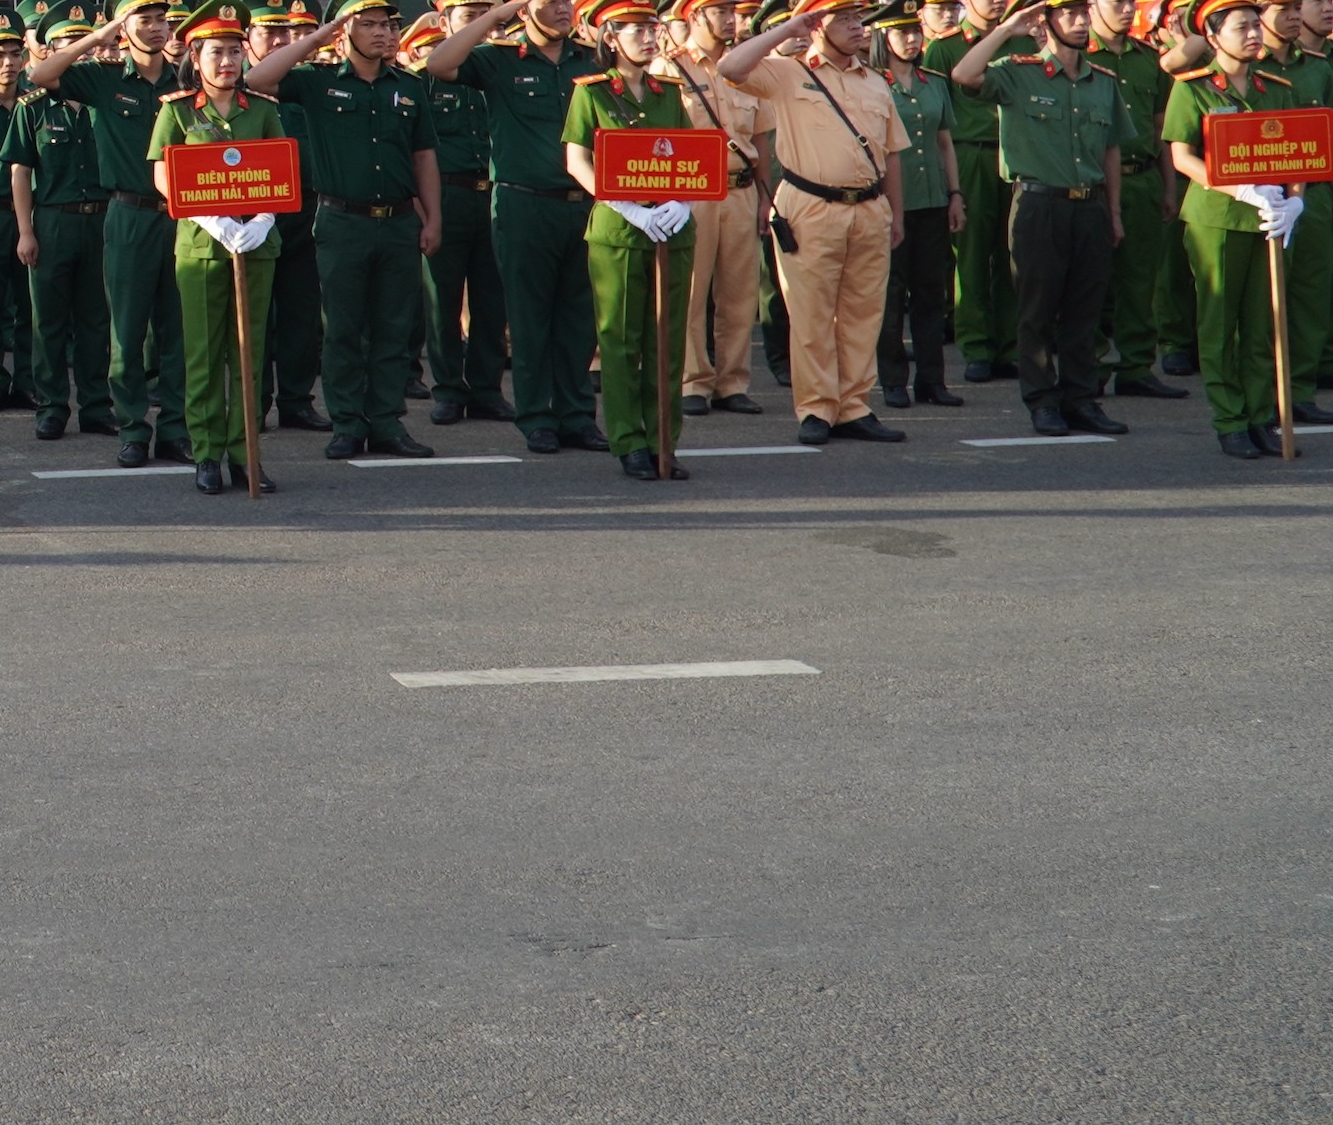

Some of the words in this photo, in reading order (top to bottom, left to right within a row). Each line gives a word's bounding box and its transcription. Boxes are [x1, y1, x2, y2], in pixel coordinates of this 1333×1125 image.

[1229, 143, 1250, 160] ĐỘI
[1253, 140, 1298, 158] NGHIỆP
[1301, 141, 1317, 156] VỤ
[627, 158, 672, 173] QUÂN
[677, 160, 700, 176] SỰ
[1222, 161, 1250, 174] CÔNG
[1253, 162, 1267, 172] AN
[1270, 158, 1303, 171] THÀNH
[1306, 155, 1326, 169] PHỐ
[197, 170, 225, 185] BIÊN
[229, 167, 271, 184] PHÒNG
[617, 174, 670, 188] THÀNH
[675, 173, 708, 189] PHỐ
[180, 188, 218, 202] THANH
[222, 184, 245, 200] HẢI,
[248, 184, 271, 198] MŨI
[274, 182, 290, 196] NÉ
